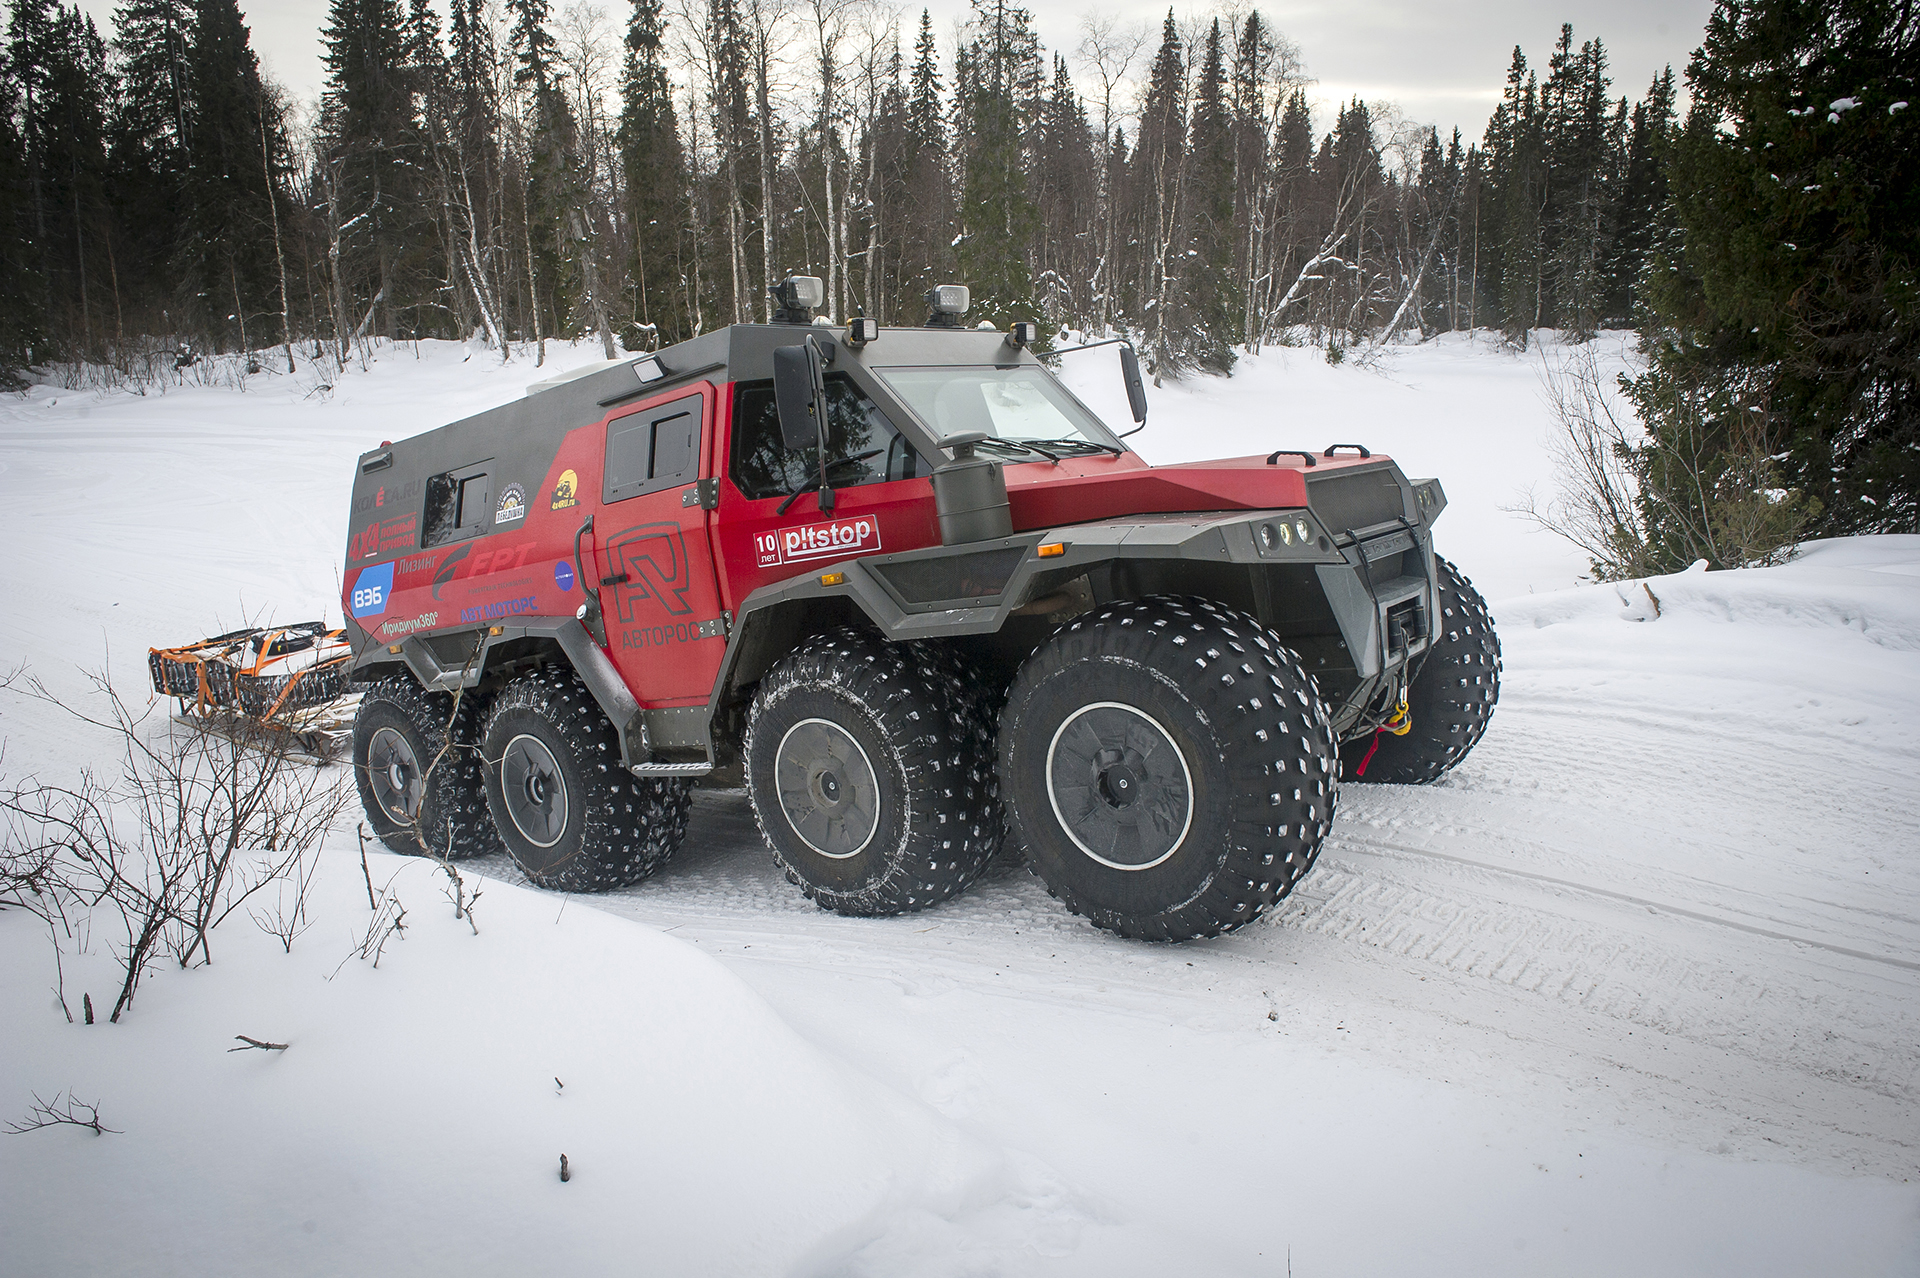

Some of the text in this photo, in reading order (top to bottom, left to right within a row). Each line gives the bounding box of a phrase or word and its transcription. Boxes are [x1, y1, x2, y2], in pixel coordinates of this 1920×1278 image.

[381, 516, 416, 539] ПОЛНЫЙ
[379, 533, 415, 552] ПРИВОД
[756, 534, 776, 553] 10
[397, 555, 438, 576] Лизинг
[466, 541, 538, 580] FPT
[760, 554, 776, 563] лет
[354, 585, 382, 609] ВЭБ
[468, 577, 533, 595] POWERTRAIN TECHNOLOGIES
[460, 596, 539, 624] АВТ МОТОРС
[622, 621, 702, 650] АВТОРОС
